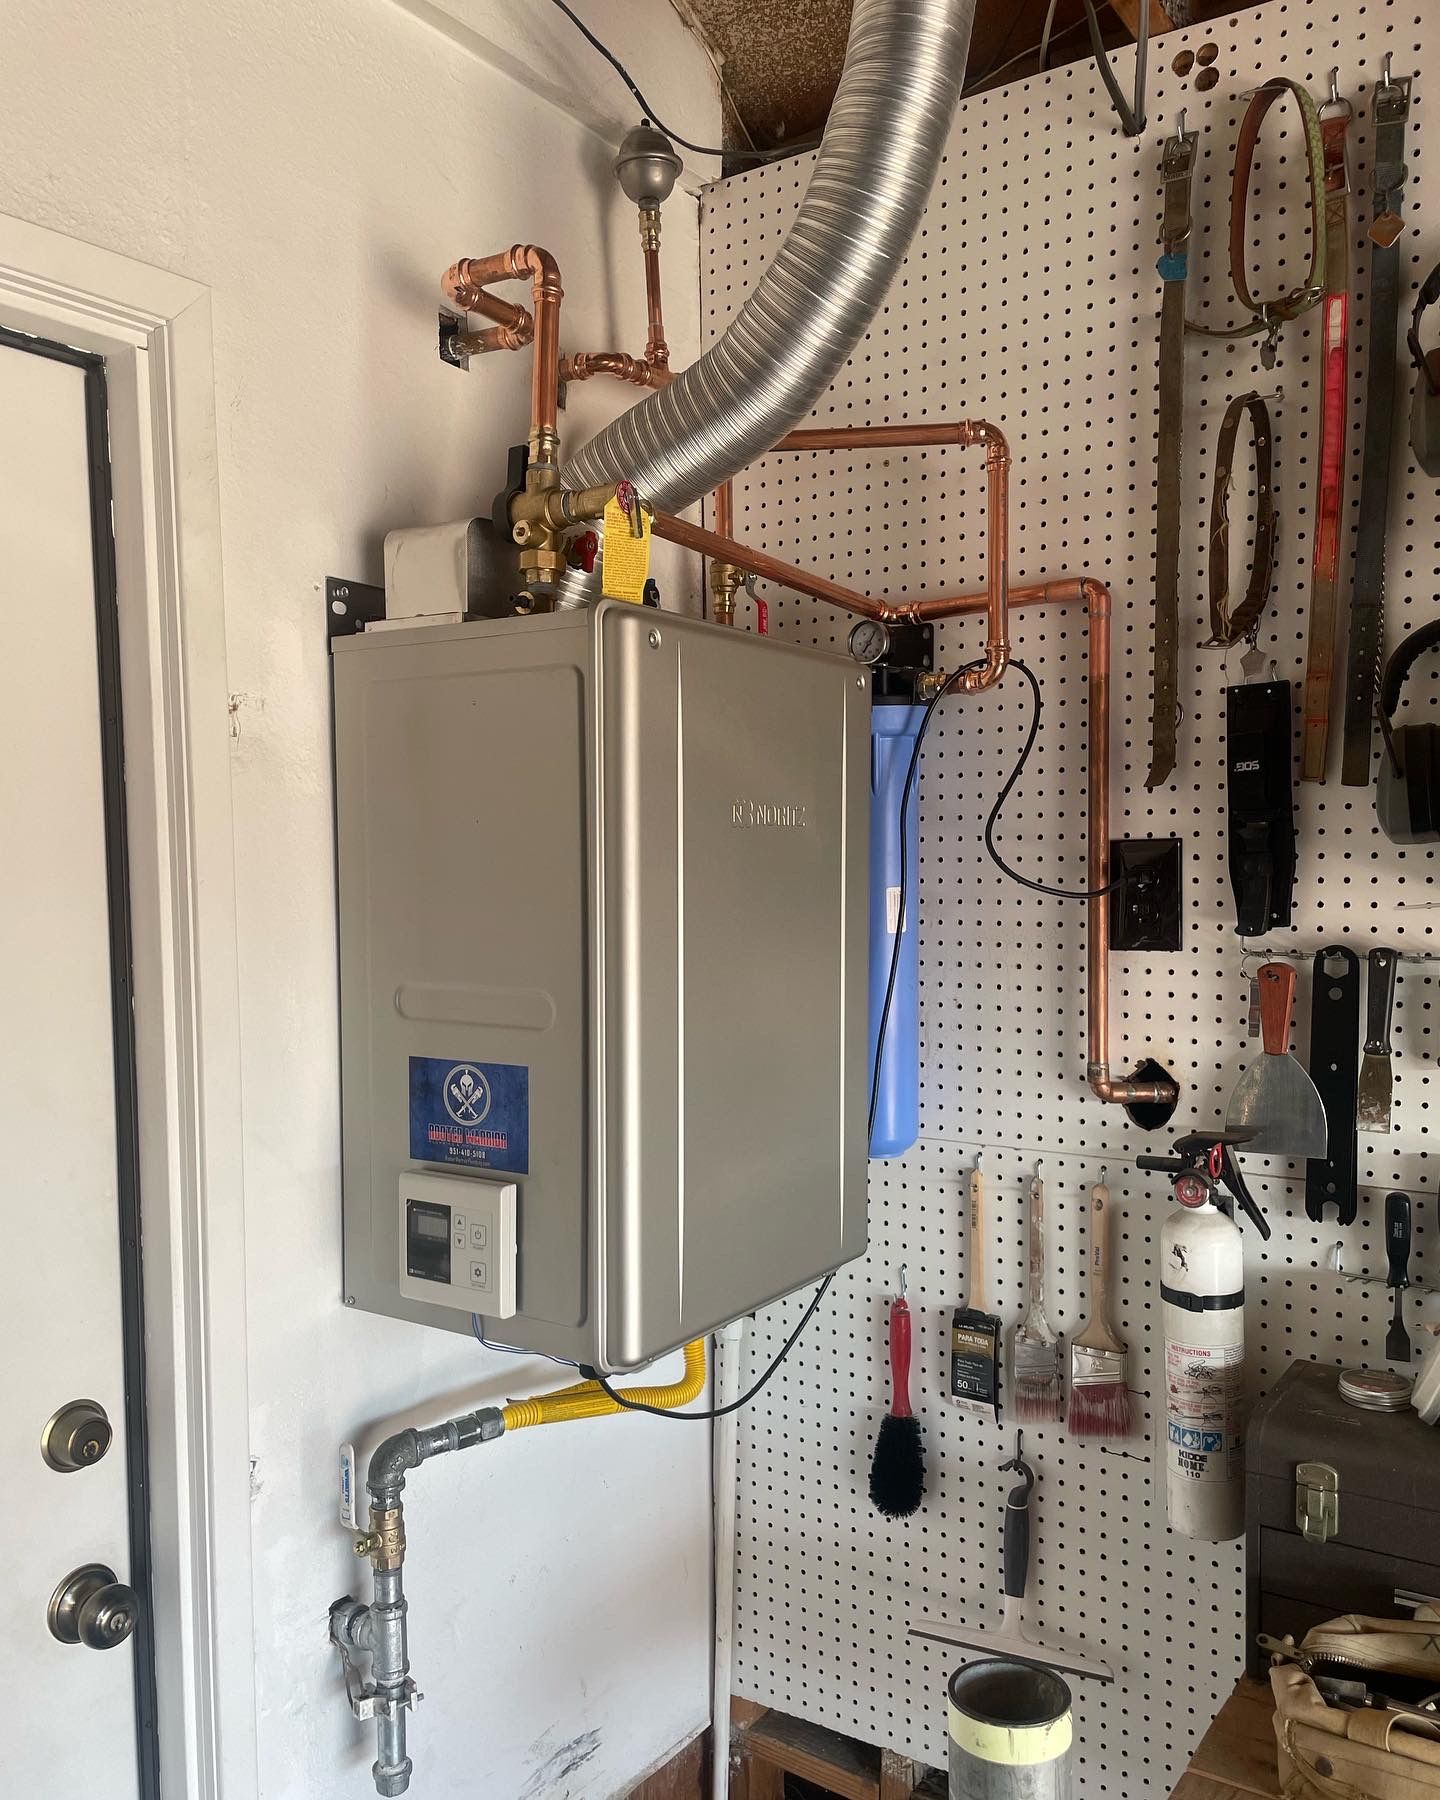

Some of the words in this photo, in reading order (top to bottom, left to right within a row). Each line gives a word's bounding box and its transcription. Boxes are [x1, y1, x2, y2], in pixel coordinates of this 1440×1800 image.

[1236, 760, 1260, 772] SOG
[428, 1123, 464, 1144] ROOTER
[465, 1128, 508, 1150] WARRIOR
[957, 1333, 974, 1343] PARA
[974, 1337, 989, 1346] TODA
[1170, 1344, 1211, 1357] INSTRUCTIONS
[957, 1380, 969, 1390] 50
[1178, 1449, 1208, 1462] KIDDE
[1177, 1457, 1205, 1472] HOME
[1185, 1470, 1201, 1478] 110
